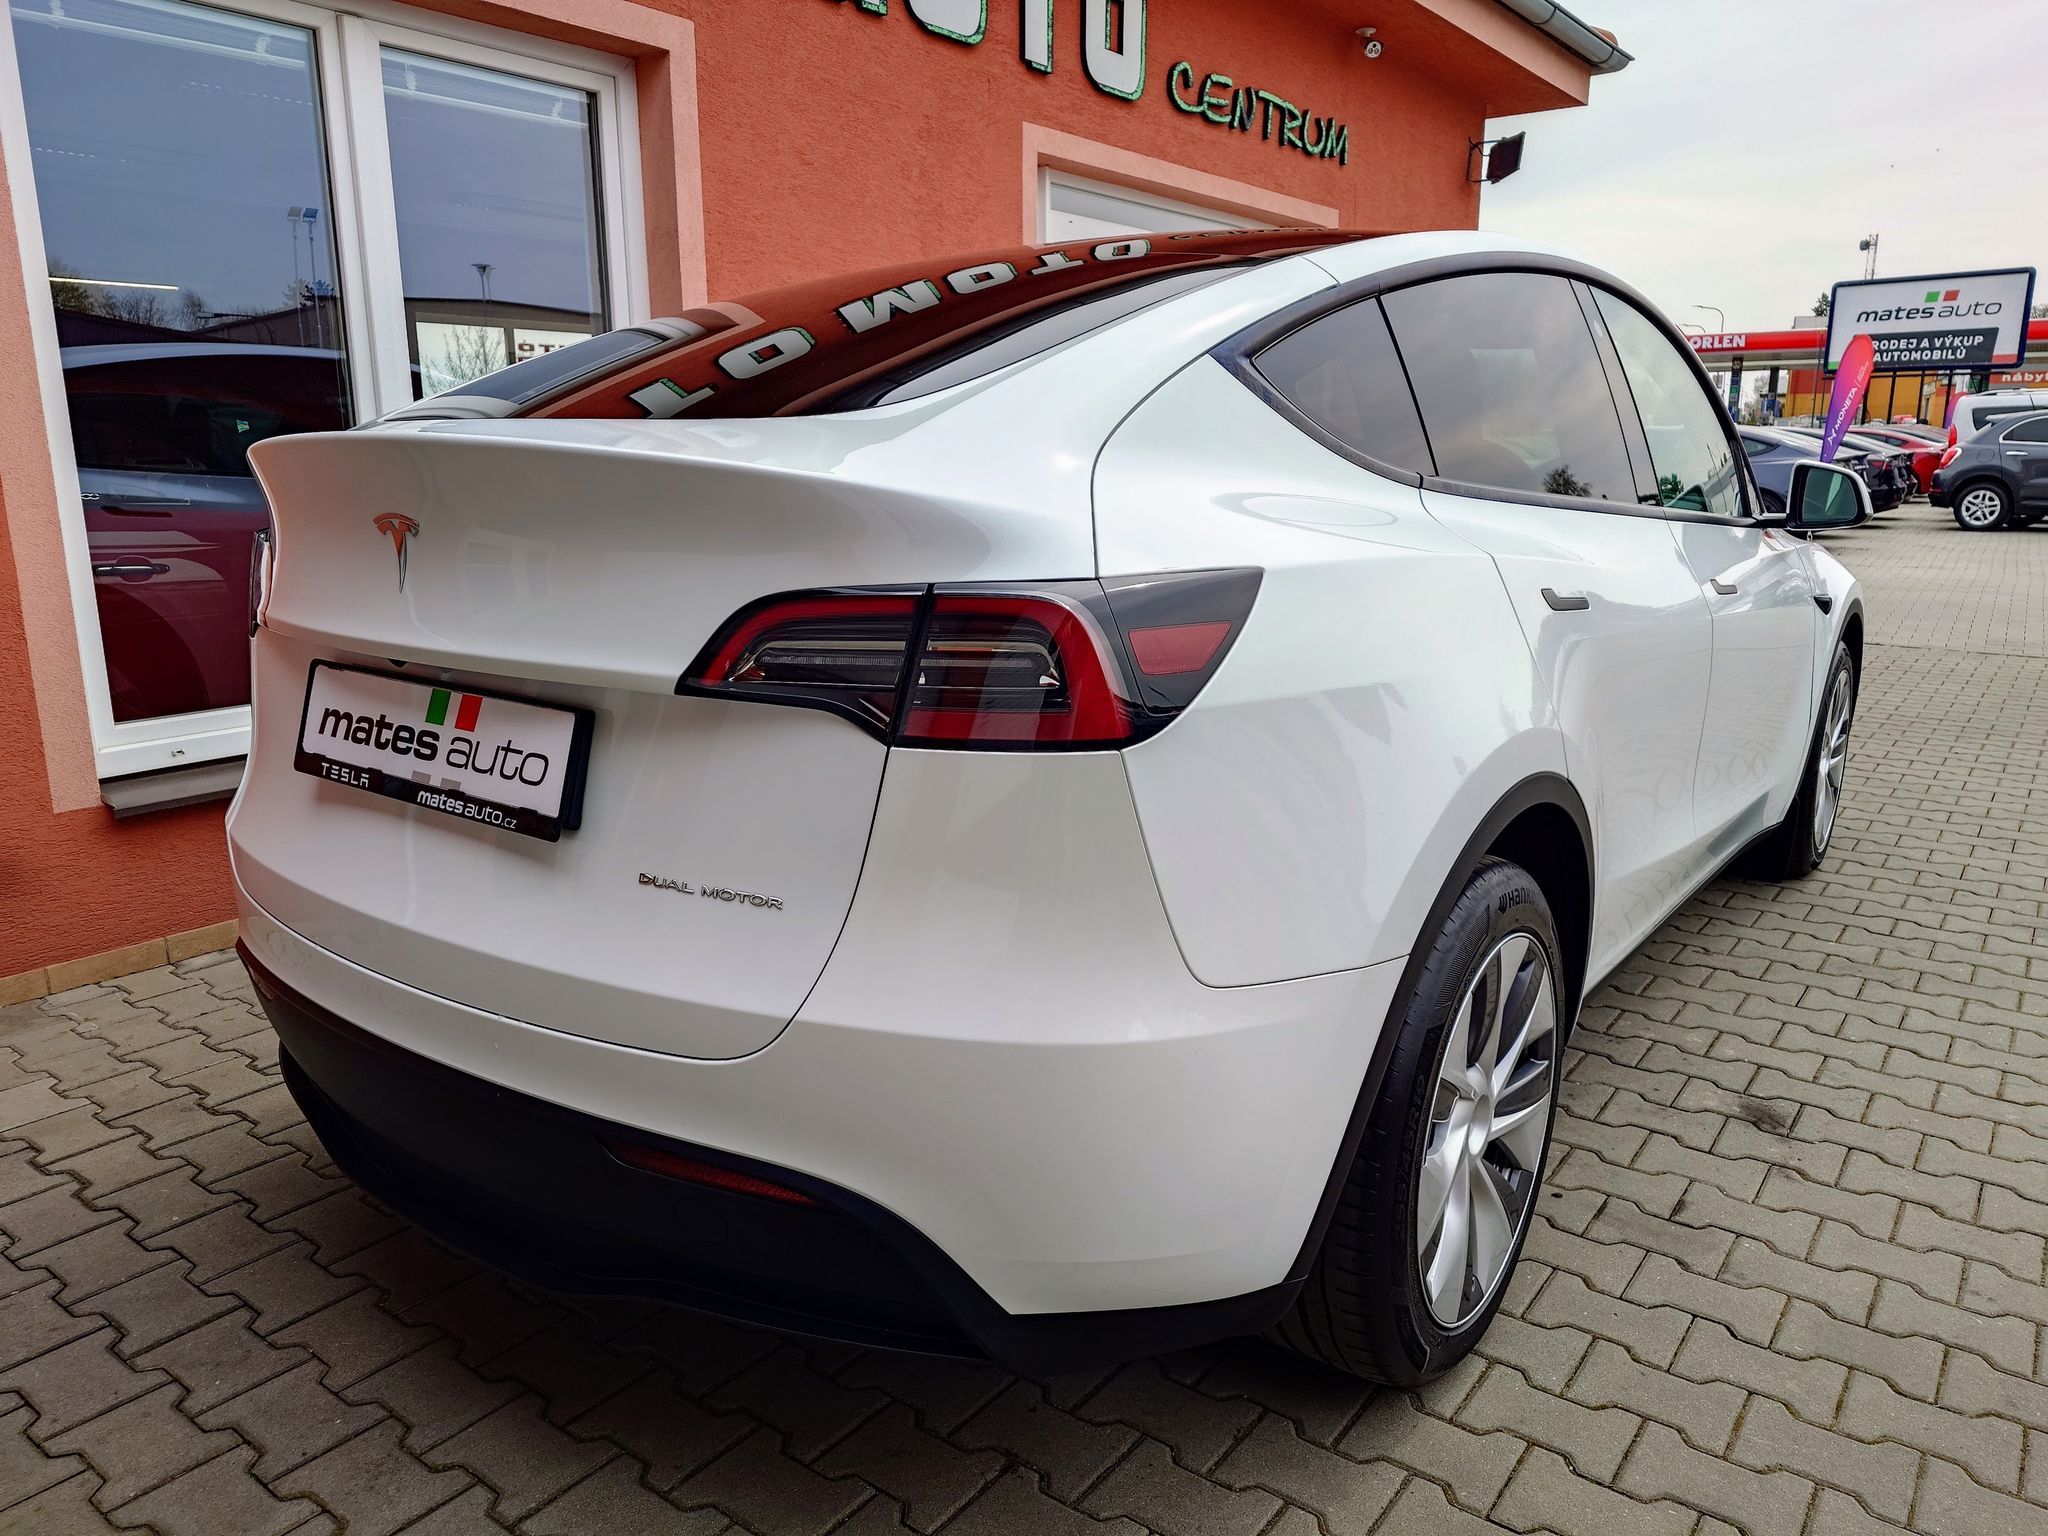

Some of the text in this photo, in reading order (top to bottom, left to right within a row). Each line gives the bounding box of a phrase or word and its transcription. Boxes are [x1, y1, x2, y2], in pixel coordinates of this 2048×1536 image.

[1166, 61, 1349, 167] CENTRUM
[1856, 301, 2003, 323] mates auto
[1689, 334, 1747, 349] ORLEN
[1872, 334, 1985, 351] RODEJ A VÝKUP
[1873, 348, 1967, 362] AUTOMOBILŮ
[1835, 387, 1858, 430] MONETA
[318, 706, 549, 787] mates auto
[321, 762, 517, 829] TESLA matesauto.cz
[638, 872, 784, 911] DUAL MOTOR
